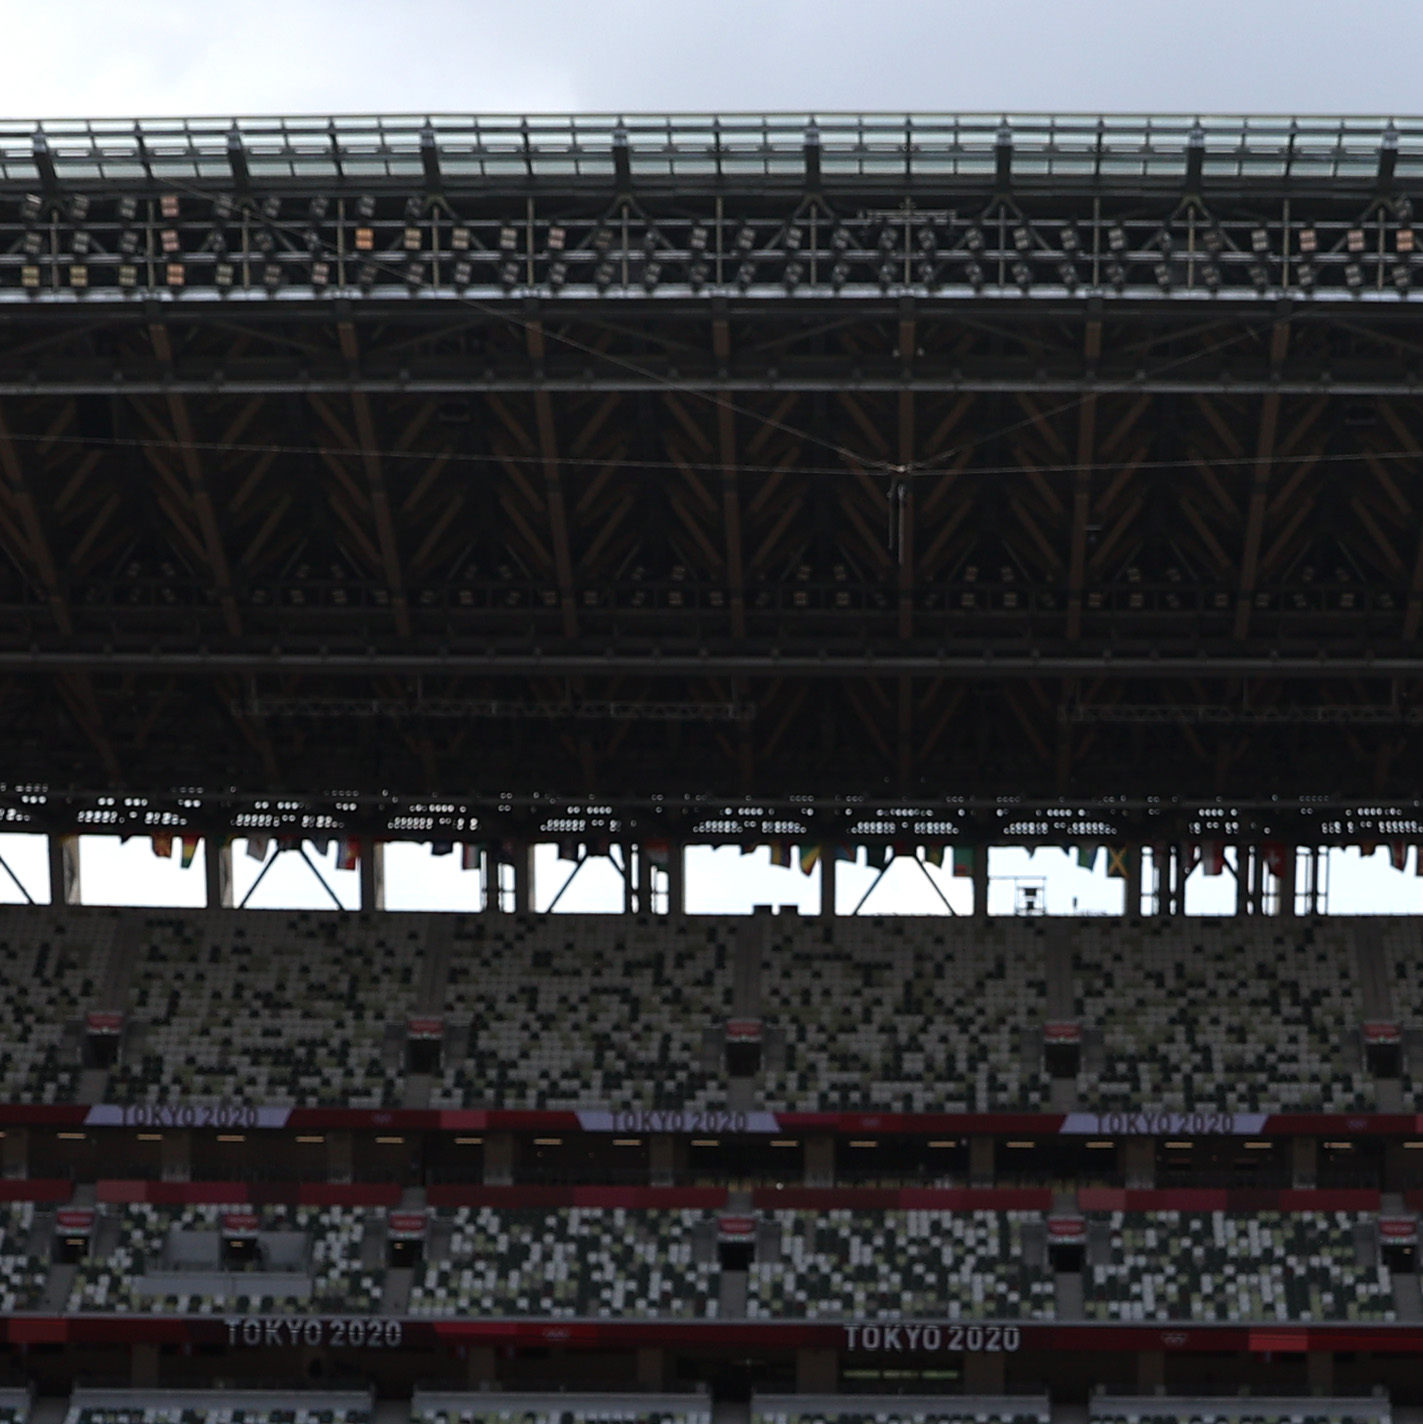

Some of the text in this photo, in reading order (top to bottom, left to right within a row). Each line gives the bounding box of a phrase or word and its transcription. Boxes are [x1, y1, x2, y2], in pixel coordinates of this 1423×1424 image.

[117, 1104, 259, 1129] TOKYO 2020
[607, 1111, 747, 1134] TOKYO 2020
[1092, 1113, 1235, 1136] TOKYO 2020
[223, 1317, 403, 1348] TOKYO 2020
[842, 1323, 1021, 1352] TOKYO 2020
